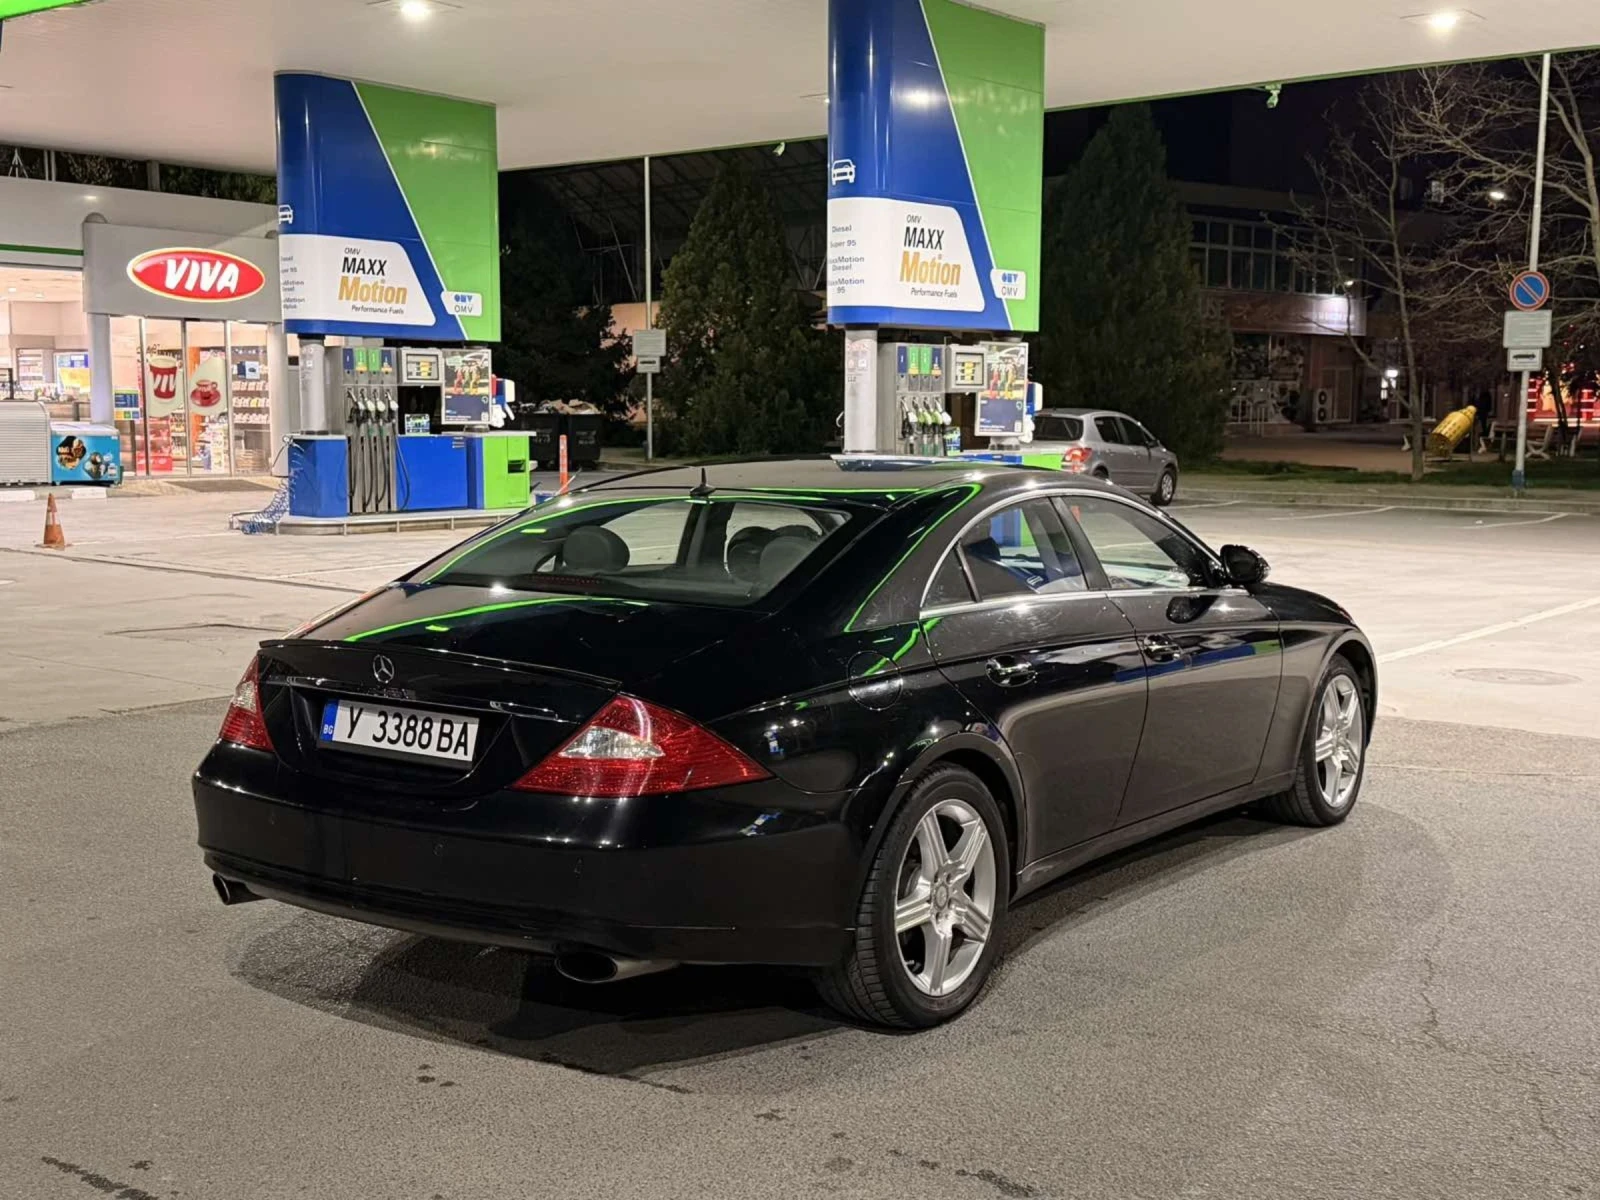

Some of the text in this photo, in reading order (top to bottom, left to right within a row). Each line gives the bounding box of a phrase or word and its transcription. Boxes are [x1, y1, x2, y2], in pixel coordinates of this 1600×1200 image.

[907, 214, 922, 224] OMV
[904, 226, 944, 250] MAXX
[344, 247, 361, 256] OMV
[342, 256, 387, 276] MAXX
[899, 250, 961, 286] Motion
[164, 257, 239, 294] VIVA
[338, 276, 408, 305] Motion
[910, 287, 958, 298] Performance Fuels
[1001, 286, 1018, 296] OMV
[351, 304, 405, 315] Performance Fuels
[454, 305, 473, 313] OMV
[323, 724, 333, 735] BG
